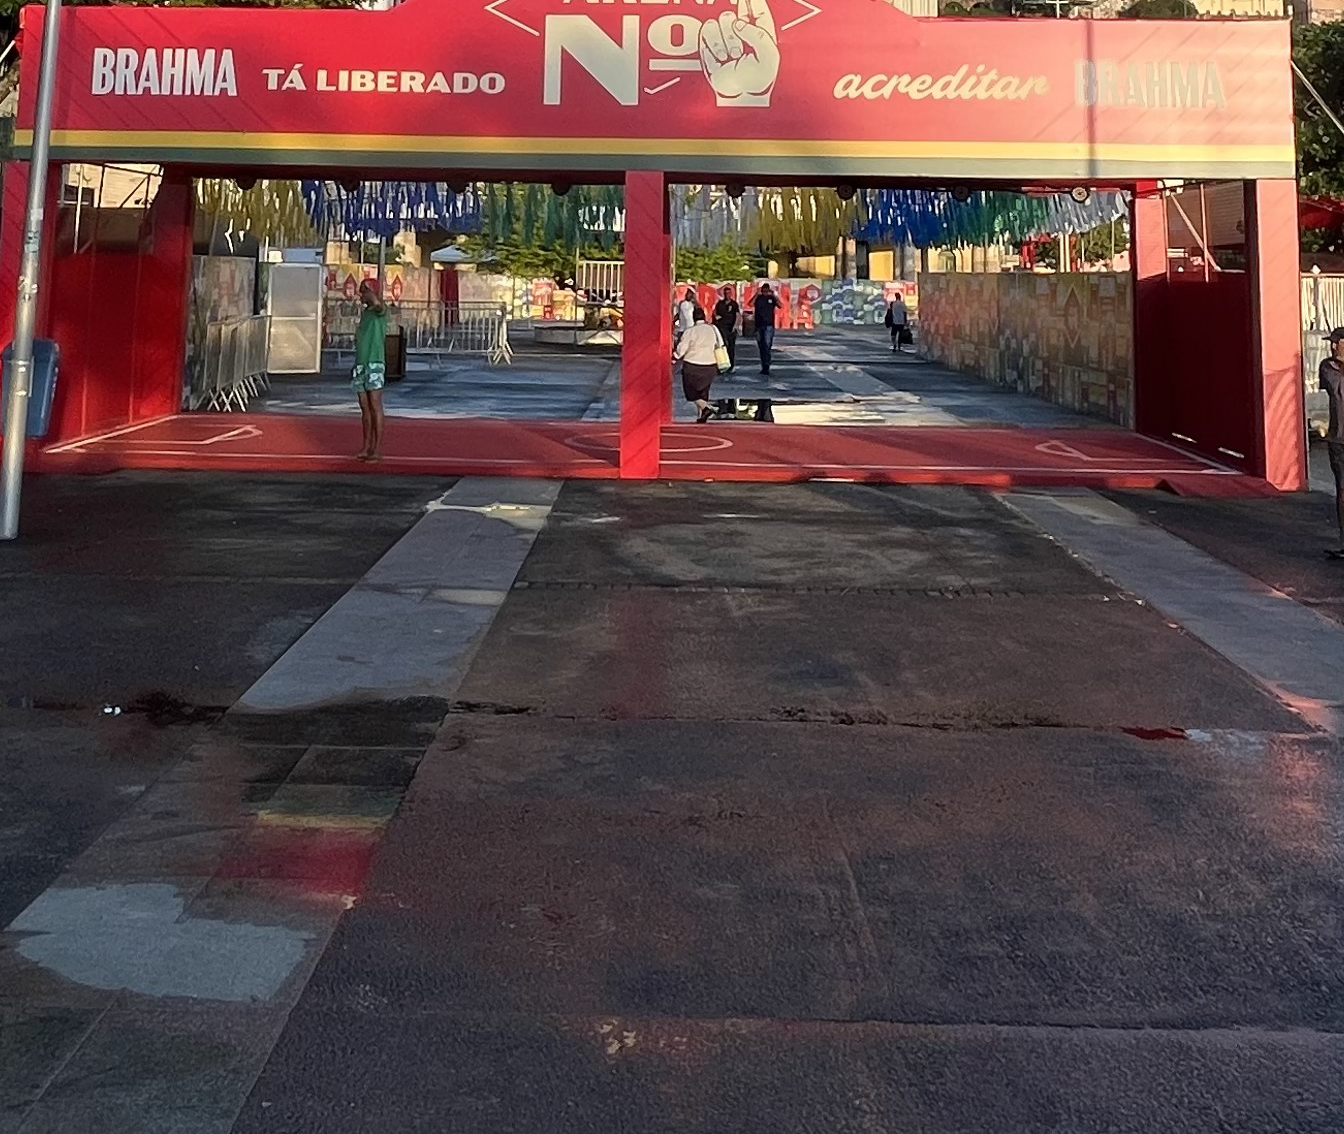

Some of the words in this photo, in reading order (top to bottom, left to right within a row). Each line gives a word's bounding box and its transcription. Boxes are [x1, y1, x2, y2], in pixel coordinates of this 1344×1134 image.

[91, 47, 238, 97] BRAHMA
[261, 63, 307, 92] TÁ
[316, 69, 506, 95] LIBERADO
[833, 64, 1050, 101] acreditar
[1074, 59, 1226, 110] BRAHMA
